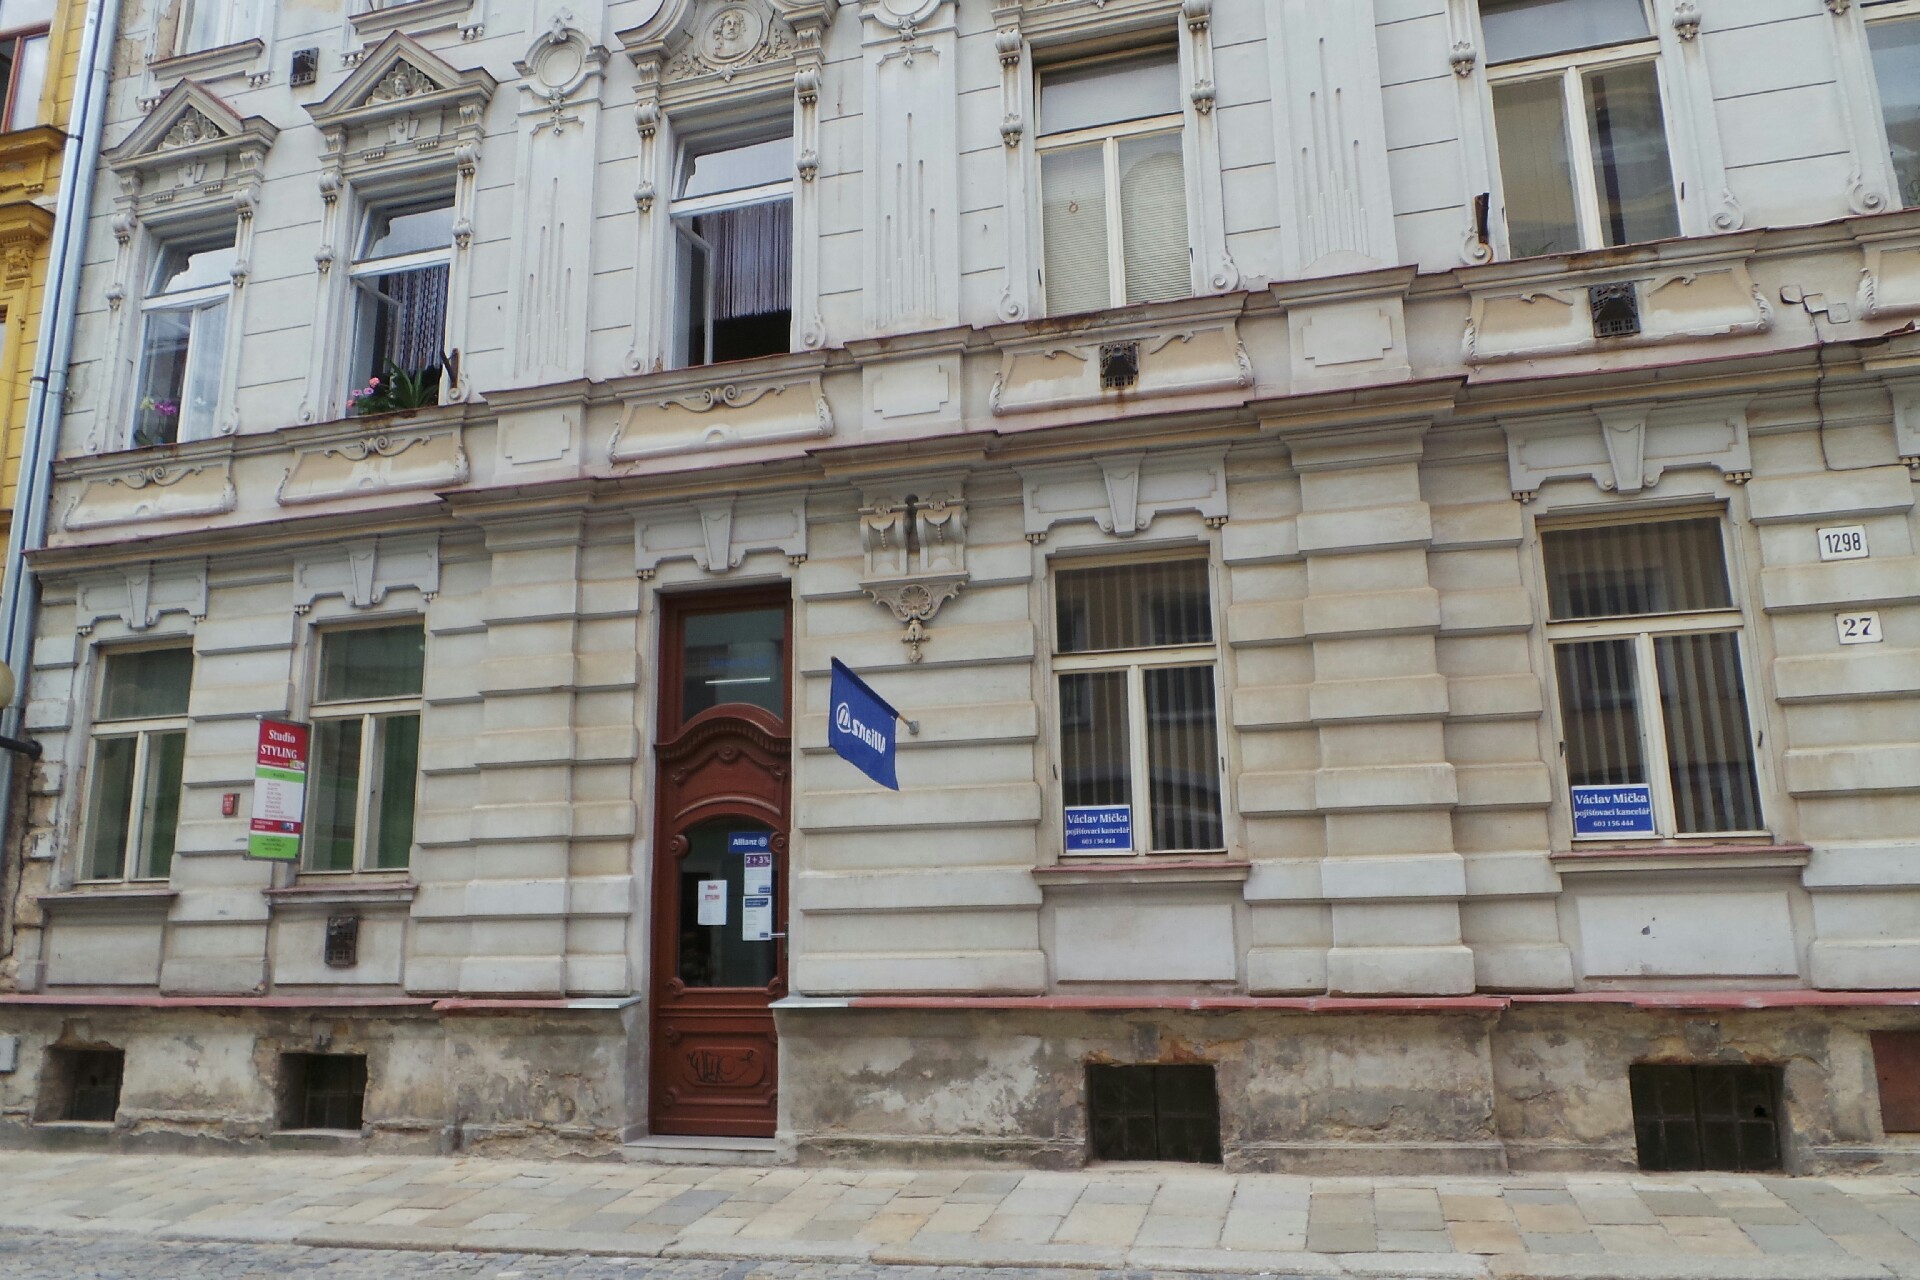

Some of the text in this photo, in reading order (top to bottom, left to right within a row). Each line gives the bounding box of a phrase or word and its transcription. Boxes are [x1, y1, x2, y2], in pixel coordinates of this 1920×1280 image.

[1825, 532, 1861, 553] 1298
[1842, 617, 1872, 637] 27
[268, 729, 296, 743] Studio
[260, 744, 298, 759] STYLING
[1575, 792, 1648, 804] Václav Mička
[1616, 807, 1651, 816] kancelář
[1067, 813, 1128, 823] Václav Mička
[732, 838, 758, 846] Allianz
[746, 856, 751, 864] 2
